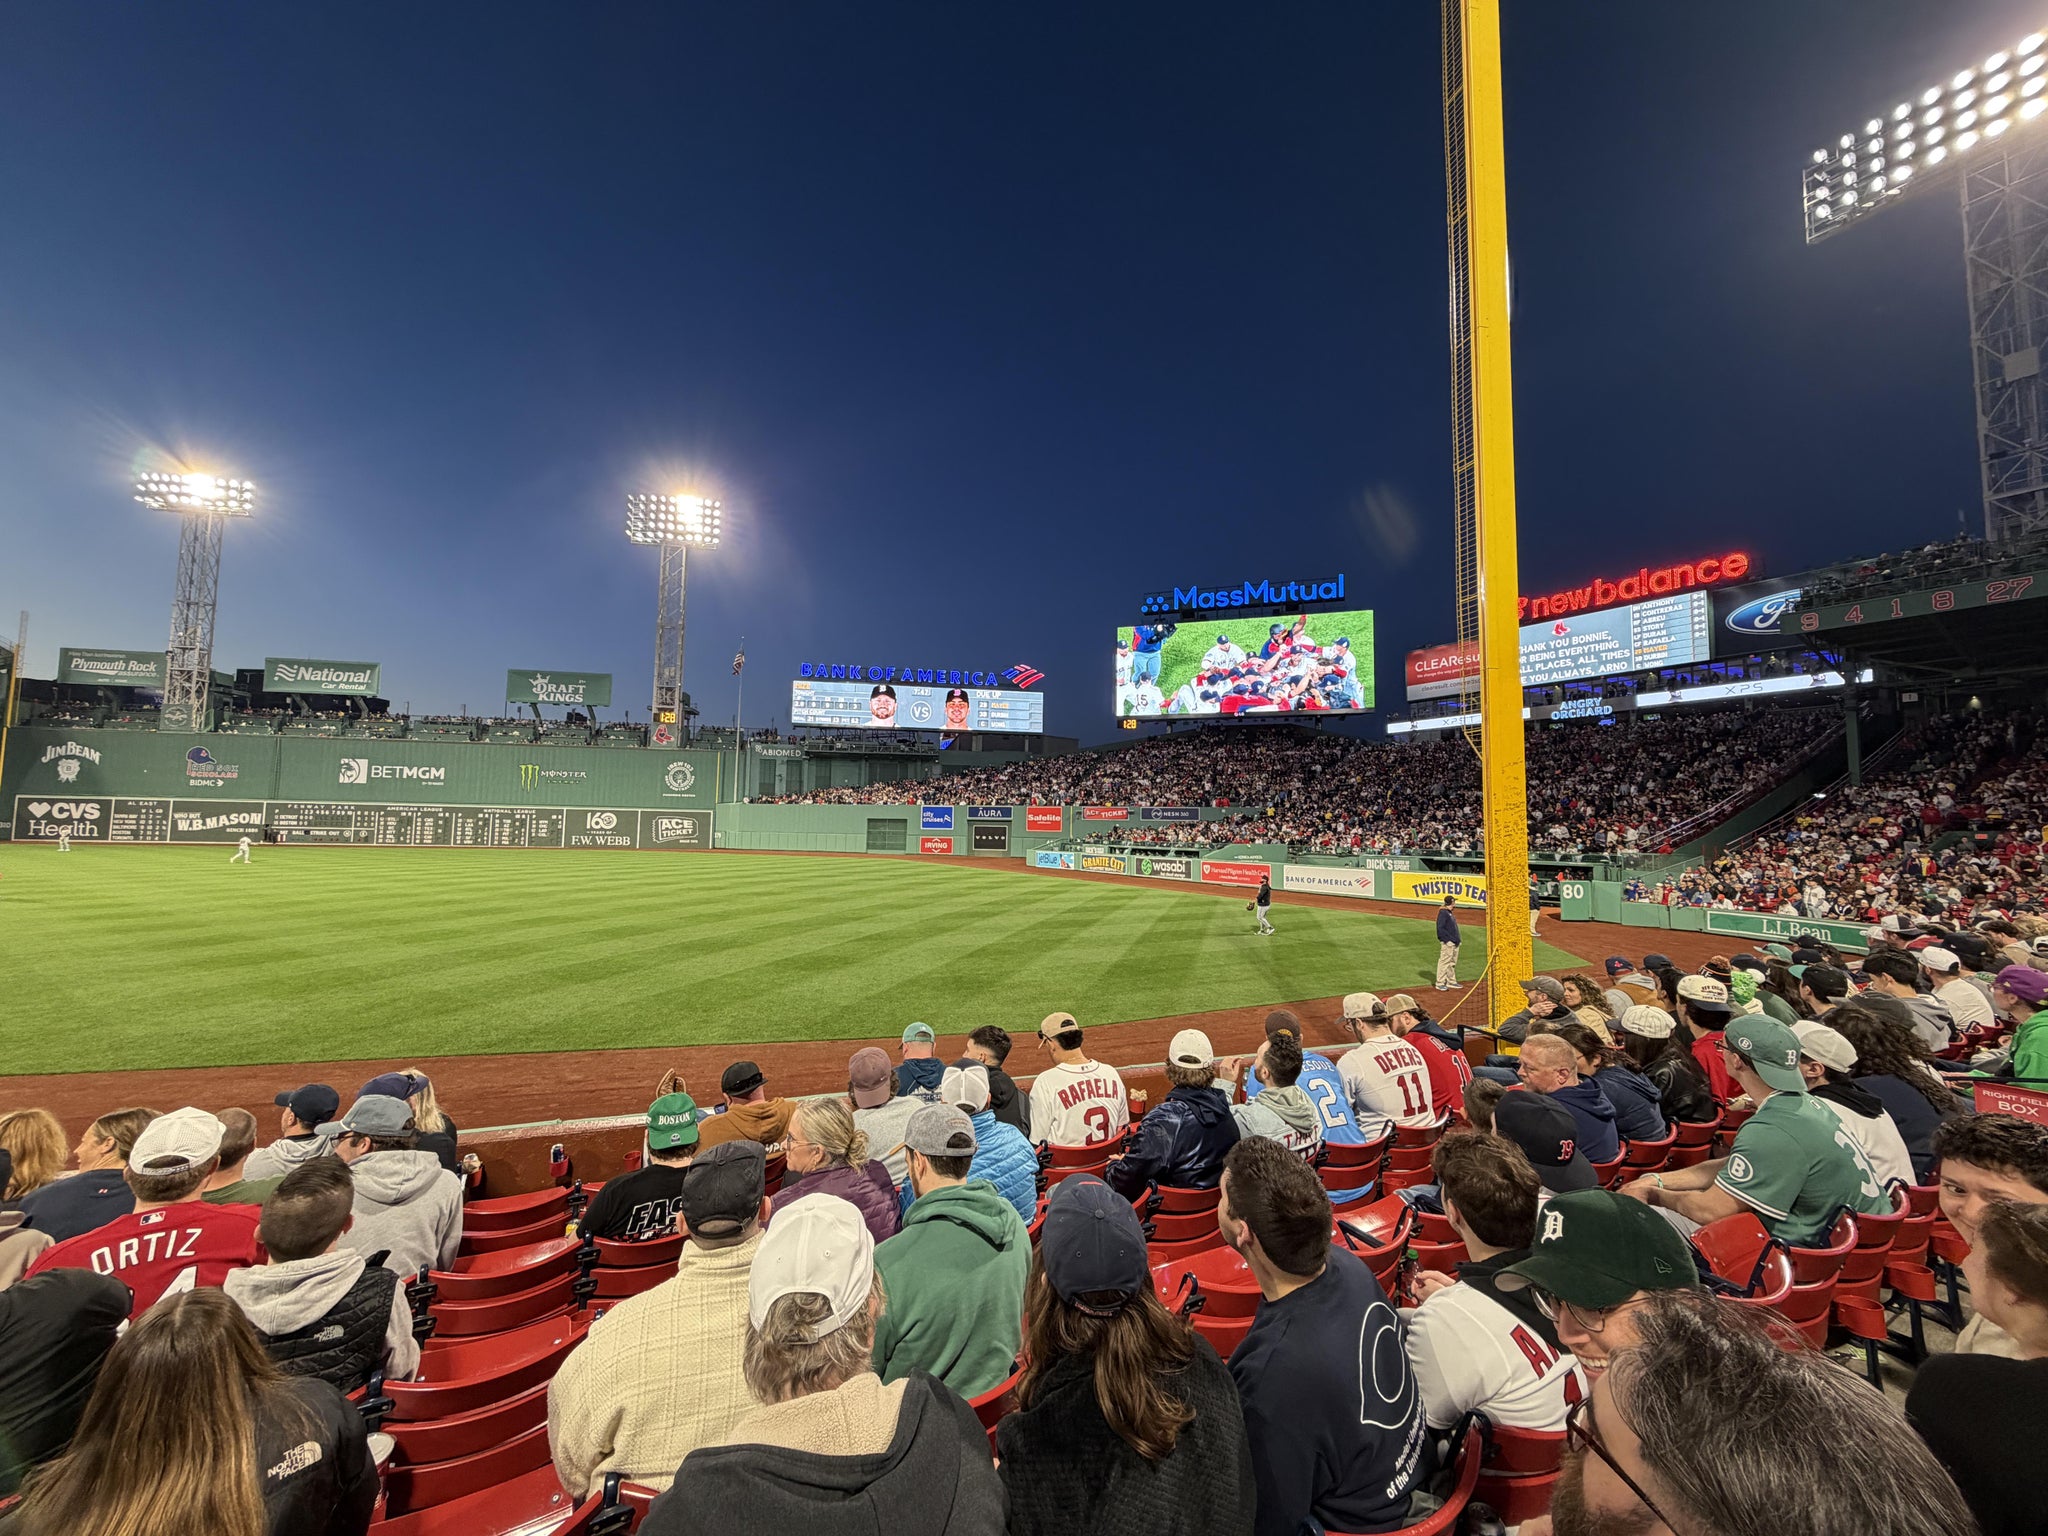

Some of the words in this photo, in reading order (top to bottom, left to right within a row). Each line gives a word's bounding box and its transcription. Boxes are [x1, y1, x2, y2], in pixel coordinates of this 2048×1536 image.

[1174, 574, 1345, 610] MassMutual
[1531, 586, 1592, 618] new
[1592, 552, 1750, 607] balance
[1801, 613, 1819, 631] 9
[1844, 606, 1863, 624] 4
[1891, 599, 1903, 617] 1
[1931, 591, 1954, 611] 8
[1986, 577, 2033, 603] 27
[1642, 622, 1665, 632] STORY
[1519, 643, 1549, 655] HANK
[1549, 638, 1572, 649] YOU
[1572, 631, 1613, 644] BONNIE,
[1530, 651, 1556, 661] BEING
[1558, 641, 1619, 658] EVERYTHING
[71, 658, 125, 672] Plymouth
[128, 661, 158, 672] Rock
[1415, 653, 1480, 673] CLEAResu
[1535, 659, 1575, 672] PLACES,
[1577, 656, 1599, 666] ALL
[1602, 650, 1631, 661] TIMES
[800, 662, 862, 680] BANK
[868, 666, 896, 682] OF
[901, 667, 998, 687] AMERICA
[1530, 673, 1549, 684] YOU
[1550, 667, 1595, 682] ALWAYS,
[1599, 662, 1628, 673] ARNO
[338, 683, 367, 691] Rental
[532, 683, 587, 694] DRAFT
[1725, 682, 1763, 695] XPS
[538, 692, 583, 703] KINGS
[1559, 697, 1603, 711] ANGRY
[913, 706, 929, 718] VS
[1551, 705, 1613, 720] ORCHARD
[41, 745, 66, 763] JIM
[66, 742, 103, 765] BEAM
[191, 764, 215, 773] RED
[217, 764, 240, 773] SOX
[371, 765, 446, 780] BETMGM
[190, 779, 216, 787] BIDMC
[51, 803, 101, 820] CVS
[1027, 814, 1061, 822] Safelite
[1101, 810, 1128, 818] TICKET
[586, 812, 618, 830] 160
[661, 818, 693, 829] ACE
[571, 836, 593, 846] F.W.
[595, 836, 631, 846] WEBB
[662, 829, 694, 838] TICKET
[1082, 857, 1110, 868] GRANITE
[1110, 859, 1126, 873] CITY
[1152, 861, 1186, 873] wasabi
[1366, 858, 1393, 870] DICK'S
[1285, 875, 1305, 884] BANK
[1306, 877, 1316, 885] OF
[1317, 878, 1353, 887] AMERICA
[1412, 880, 1463, 898] TWISTED
[1464, 884, 1487, 903] TEA
[1563, 884, 1584, 899] 80
[1301, 1058, 1335, 1072] ESQUE
[1374, 1048, 1422, 1074] DEVERS
[1785, 1050, 1797, 1066] B
[1057, 1078, 1118, 1111] RAFAELA
[1307, 1077, 1348, 1128] 2
[1396, 1072, 1428, 1118] 11
[1983, 1090, 2019, 1101] RIGHT
[1998, 1101, 2040, 1118] BOX
[658, 1111, 691, 1125] BOSTON
[1083, 1106, 1110, 1145] 3
[1557, 1139, 1574, 1160] B
[1732, 1160, 1745, 1176] B
[1541, 1209, 1563, 1244] D
[90, 1228, 204, 1276] ORTIZ
[283, 1443, 304, 1458] THE
[267, 1452, 305, 1478] NORTH
[279, 1461, 305, 1480] FACE
[1387, 1480, 1398, 1500] of
[1395, 1470, 1409, 1491] the
